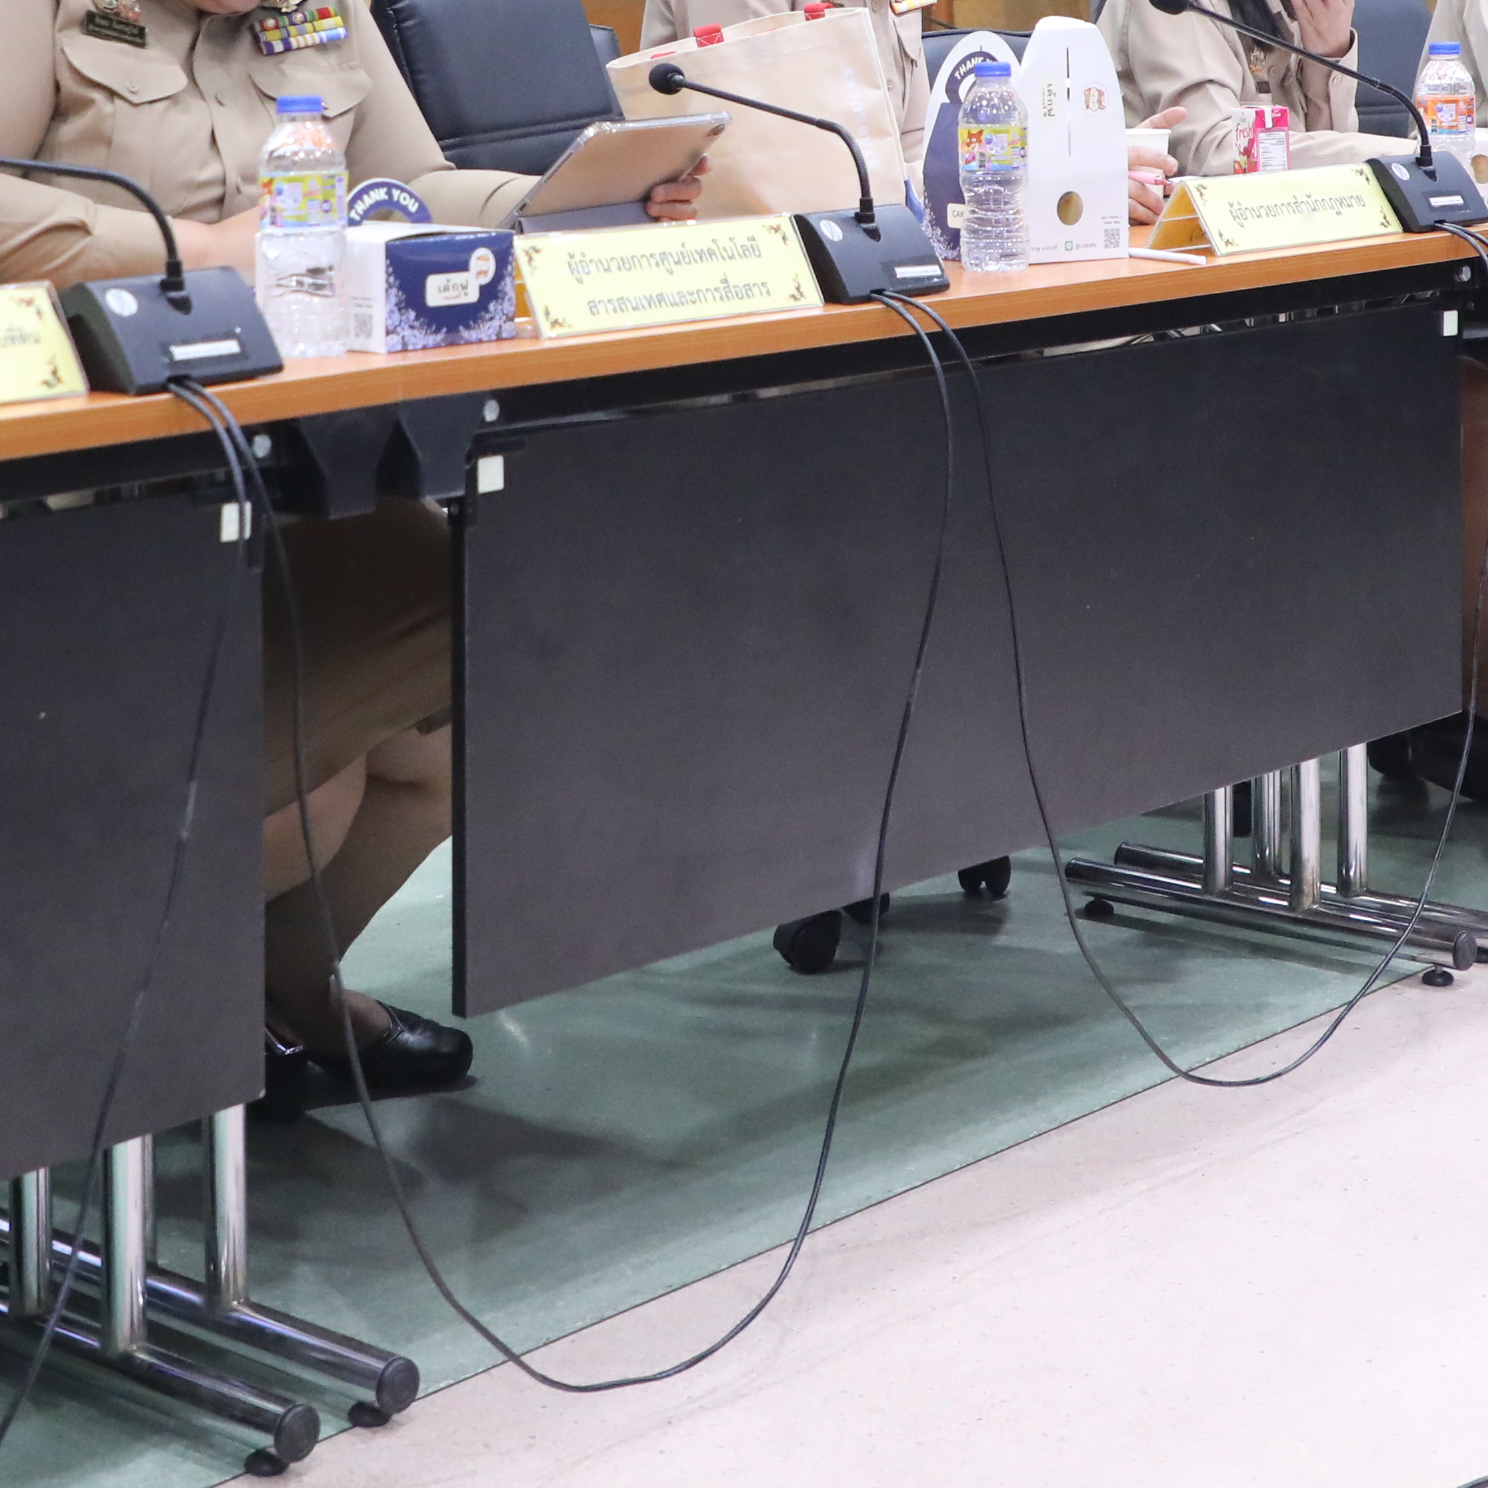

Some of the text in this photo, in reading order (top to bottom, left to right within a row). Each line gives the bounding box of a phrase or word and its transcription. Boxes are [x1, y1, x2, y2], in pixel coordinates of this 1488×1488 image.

[954, 56, 984, 80] THANK
[349, 187, 389, 221] THANK
[391, 188, 420, 214] YOU
[567, 235, 762, 285] ผู้อำนวยการศูนย์เทคโนโลยี
[587, 272, 771, 317] สารสนเทศและการสื่อสาร
